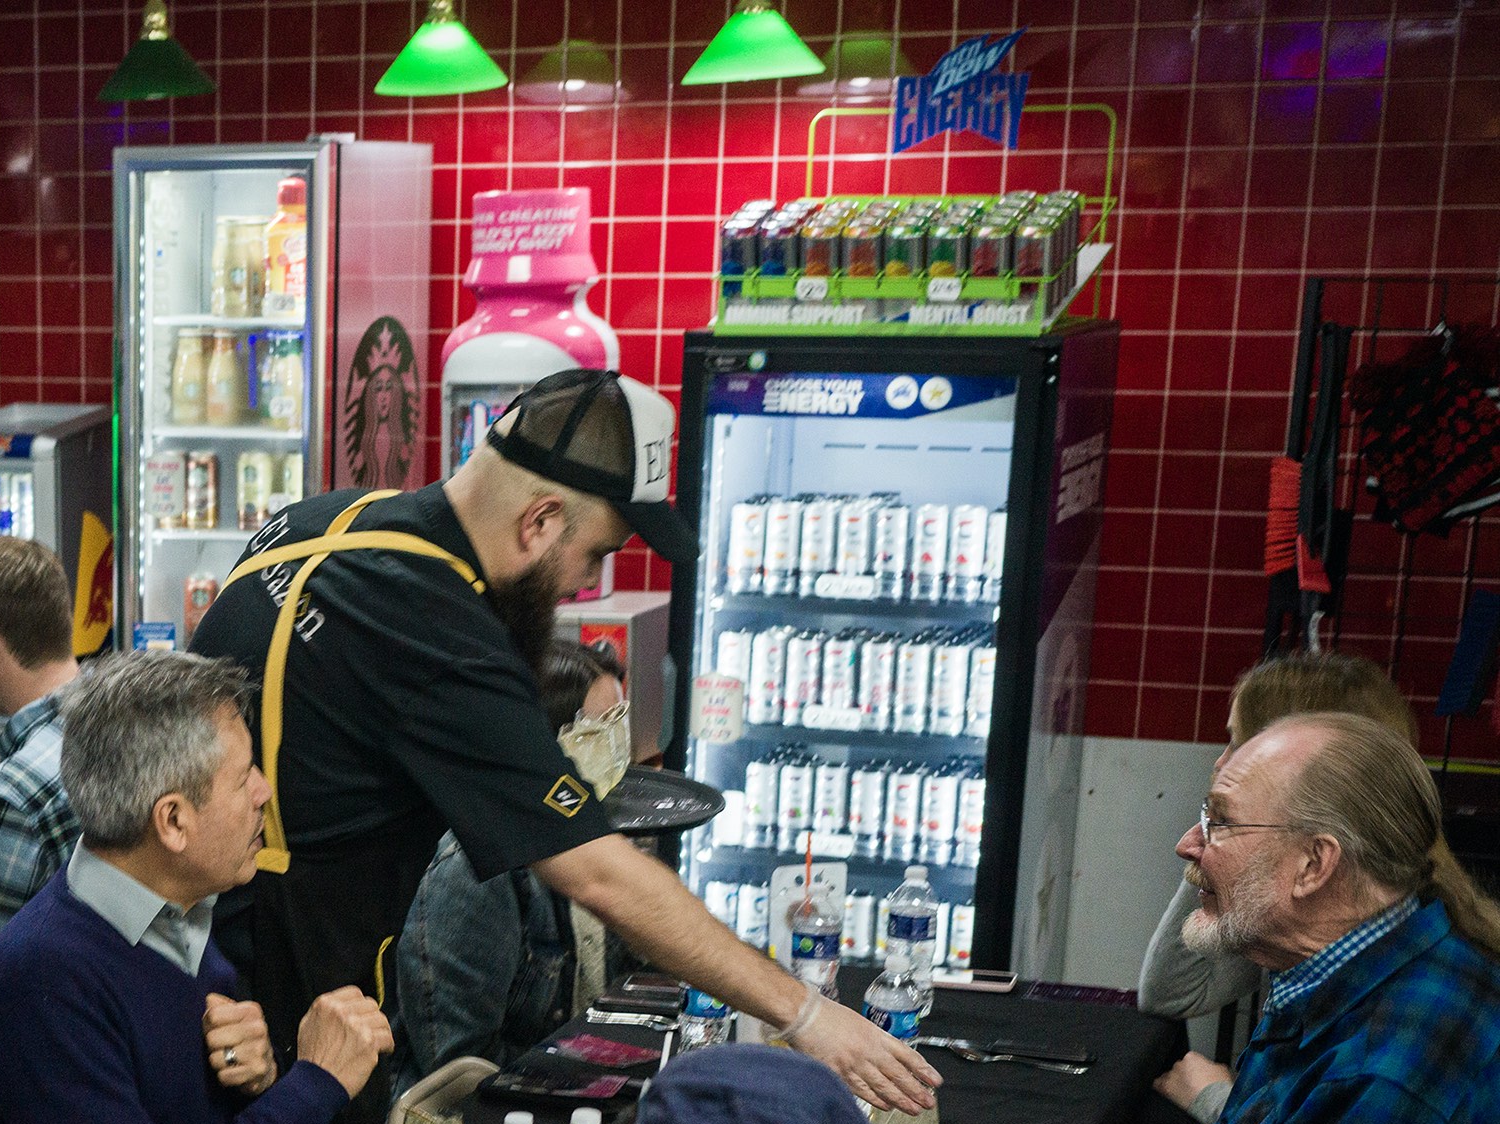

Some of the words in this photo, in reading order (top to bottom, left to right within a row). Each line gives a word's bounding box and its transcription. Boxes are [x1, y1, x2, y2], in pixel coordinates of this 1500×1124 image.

[893, 72, 1031, 154] ENERGY
[792, 304, 866, 325] SUPPORT
[908, 304, 970, 325] MENTAL
[971, 303, 1031, 325] BOOST
[764, 379, 825, 394] CHOOSE
[823, 378, 864, 394] YOUR
[763, 391, 866, 415] ENERGY
